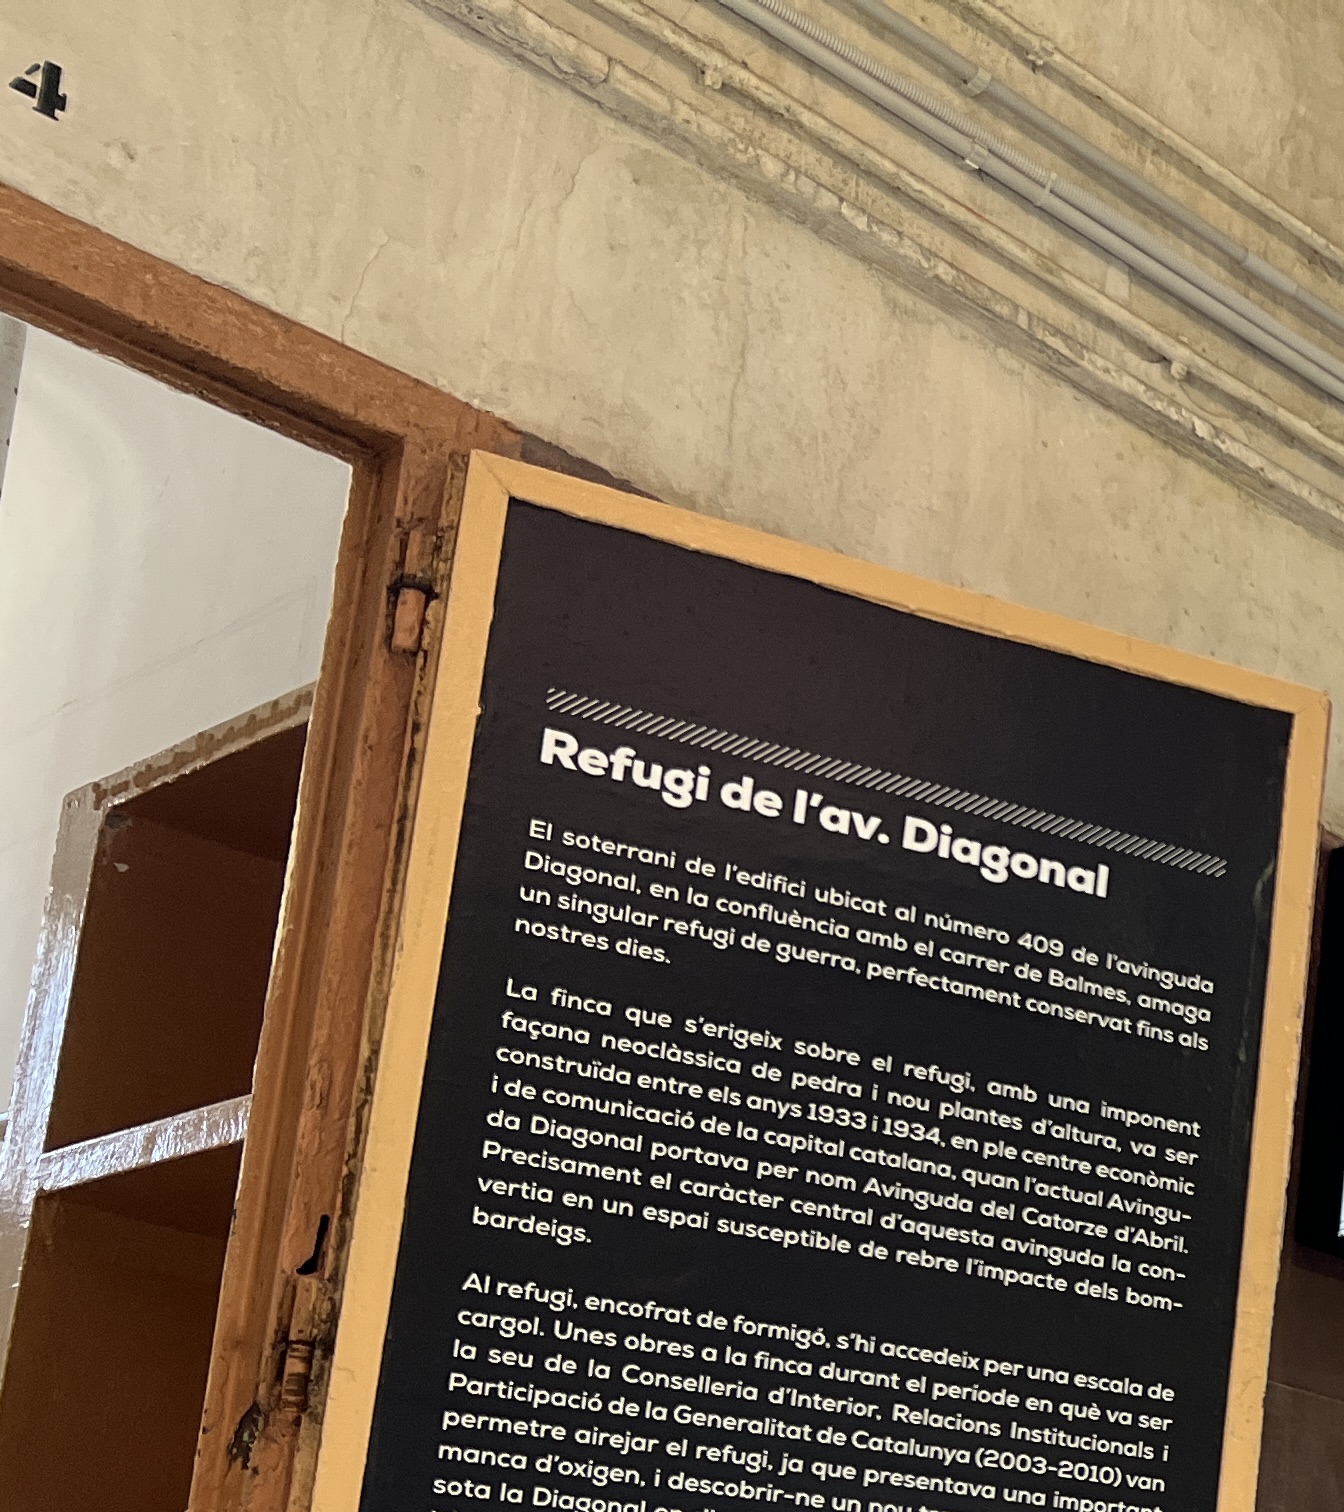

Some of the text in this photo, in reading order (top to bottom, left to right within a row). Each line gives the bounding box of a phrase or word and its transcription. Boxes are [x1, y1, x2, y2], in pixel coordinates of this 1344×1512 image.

[8, 60, 69, 121] 4
[540, 727, 1109, 898] Refugi de l'av. Diagonal
[515, 918, 670, 963] nostres dies.
[520, 886, 1208, 1050] un singular refugi de guerra, perfectament conservat fins als
[524, 850, 1211, 1024] Diagonal, en la confluència amb el carrer de Balmes, amaga
[529, 818, 1214, 993] El soterrani de l'edifici ubicat al número 409 de l'avinguda
[496, 1047, 1195, 1195] construïda entre els anys 1933 i 1934, en ple centre econòmic
[501, 1011, 1199, 1165] façana neoclàssica de pedra i nou plantes d'altura, va ser
[506, 977, 1201, 1137] La finca que s'erigeix sobre el refugi, amb una imponent
